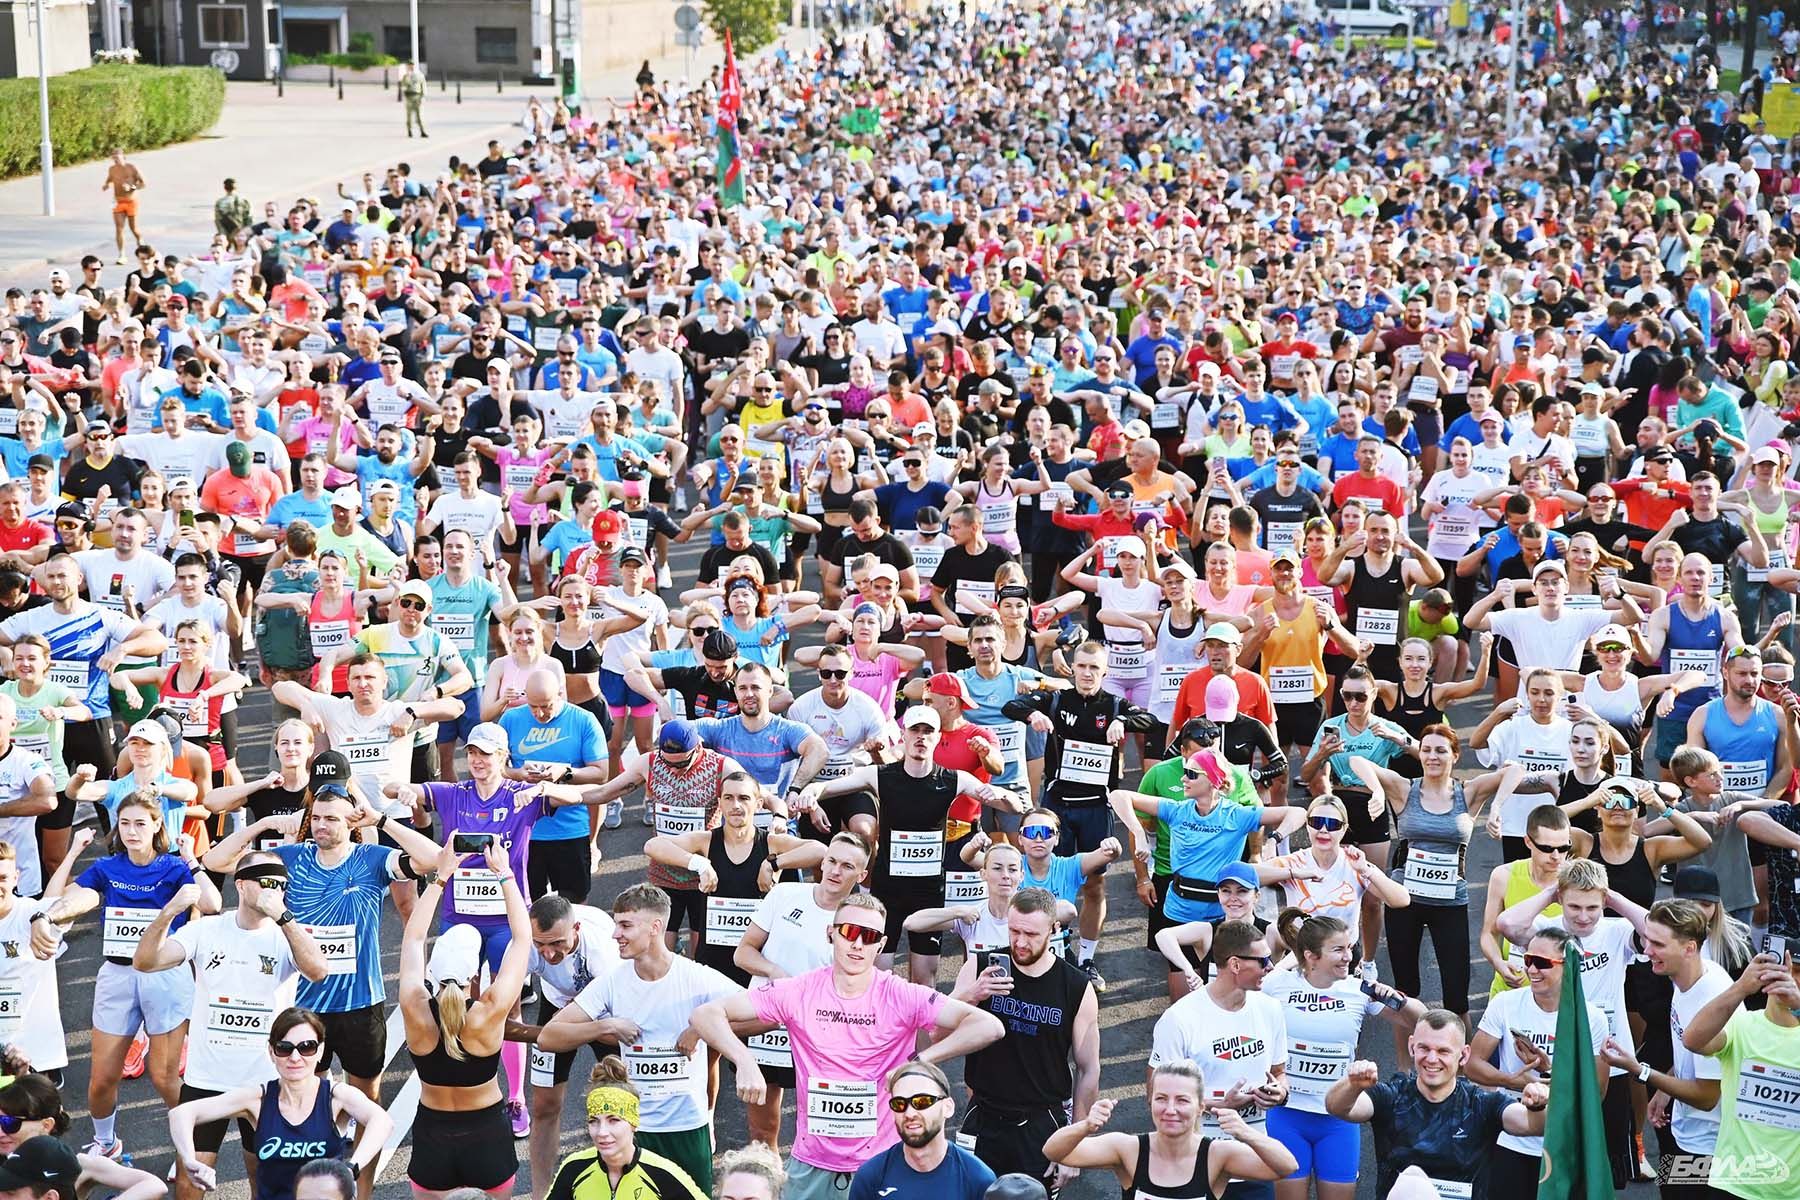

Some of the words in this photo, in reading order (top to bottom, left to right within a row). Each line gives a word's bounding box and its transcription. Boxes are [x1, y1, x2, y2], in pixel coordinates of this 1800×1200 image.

[440, 627, 466, 635] 11027
[1364, 621, 1391, 630] 12828
[317, 633, 343, 643] 10109
[1116, 657, 1139, 665] 11426
[1679, 663, 1708, 671] 12667
[50, 674, 80, 684] 11908
[1169, 678, 1184, 686] 107
[1278, 680, 1304, 688] 12831
[526, 727, 561, 743] RUN
[350, 748, 380, 759] 12158
[1072, 756, 1102, 768] 12166
[316, 764, 336, 775] NYC
[819, 767, 846, 776] 0544
[1727, 776, 1758, 786] 12815
[664, 820, 694, 831] 10071
[902, 848, 934, 858] 11559
[1416, 867, 1448, 880] 11695
[466, 886, 497, 896] 11186
[956, 886, 984, 896] 12125
[717, 915, 751, 926] 11430
[116, 926, 144, 937] 1096
[320, 944, 345, 954] 894
[1579, 952, 1609, 973] CLUB
[1288, 993, 1319, 1004] RUN
[990, 995, 1062, 1026] BOXING
[1308, 1000, 1345, 1012] CLUB
[220, 1013, 260, 1028] 10376
[761, 1034, 789, 1046] 1219
[1213, 1036, 1240, 1055] RUN
[1232, 1040, 1265, 1060] CLUB
[636, 1063, 678, 1075] 10843
[1299, 1061, 1337, 1075] 11737
[1754, 1084, 1800, 1104] 10217
[821, 1100, 864, 1114] 11065
[279, 1140, 326, 1158] asics
